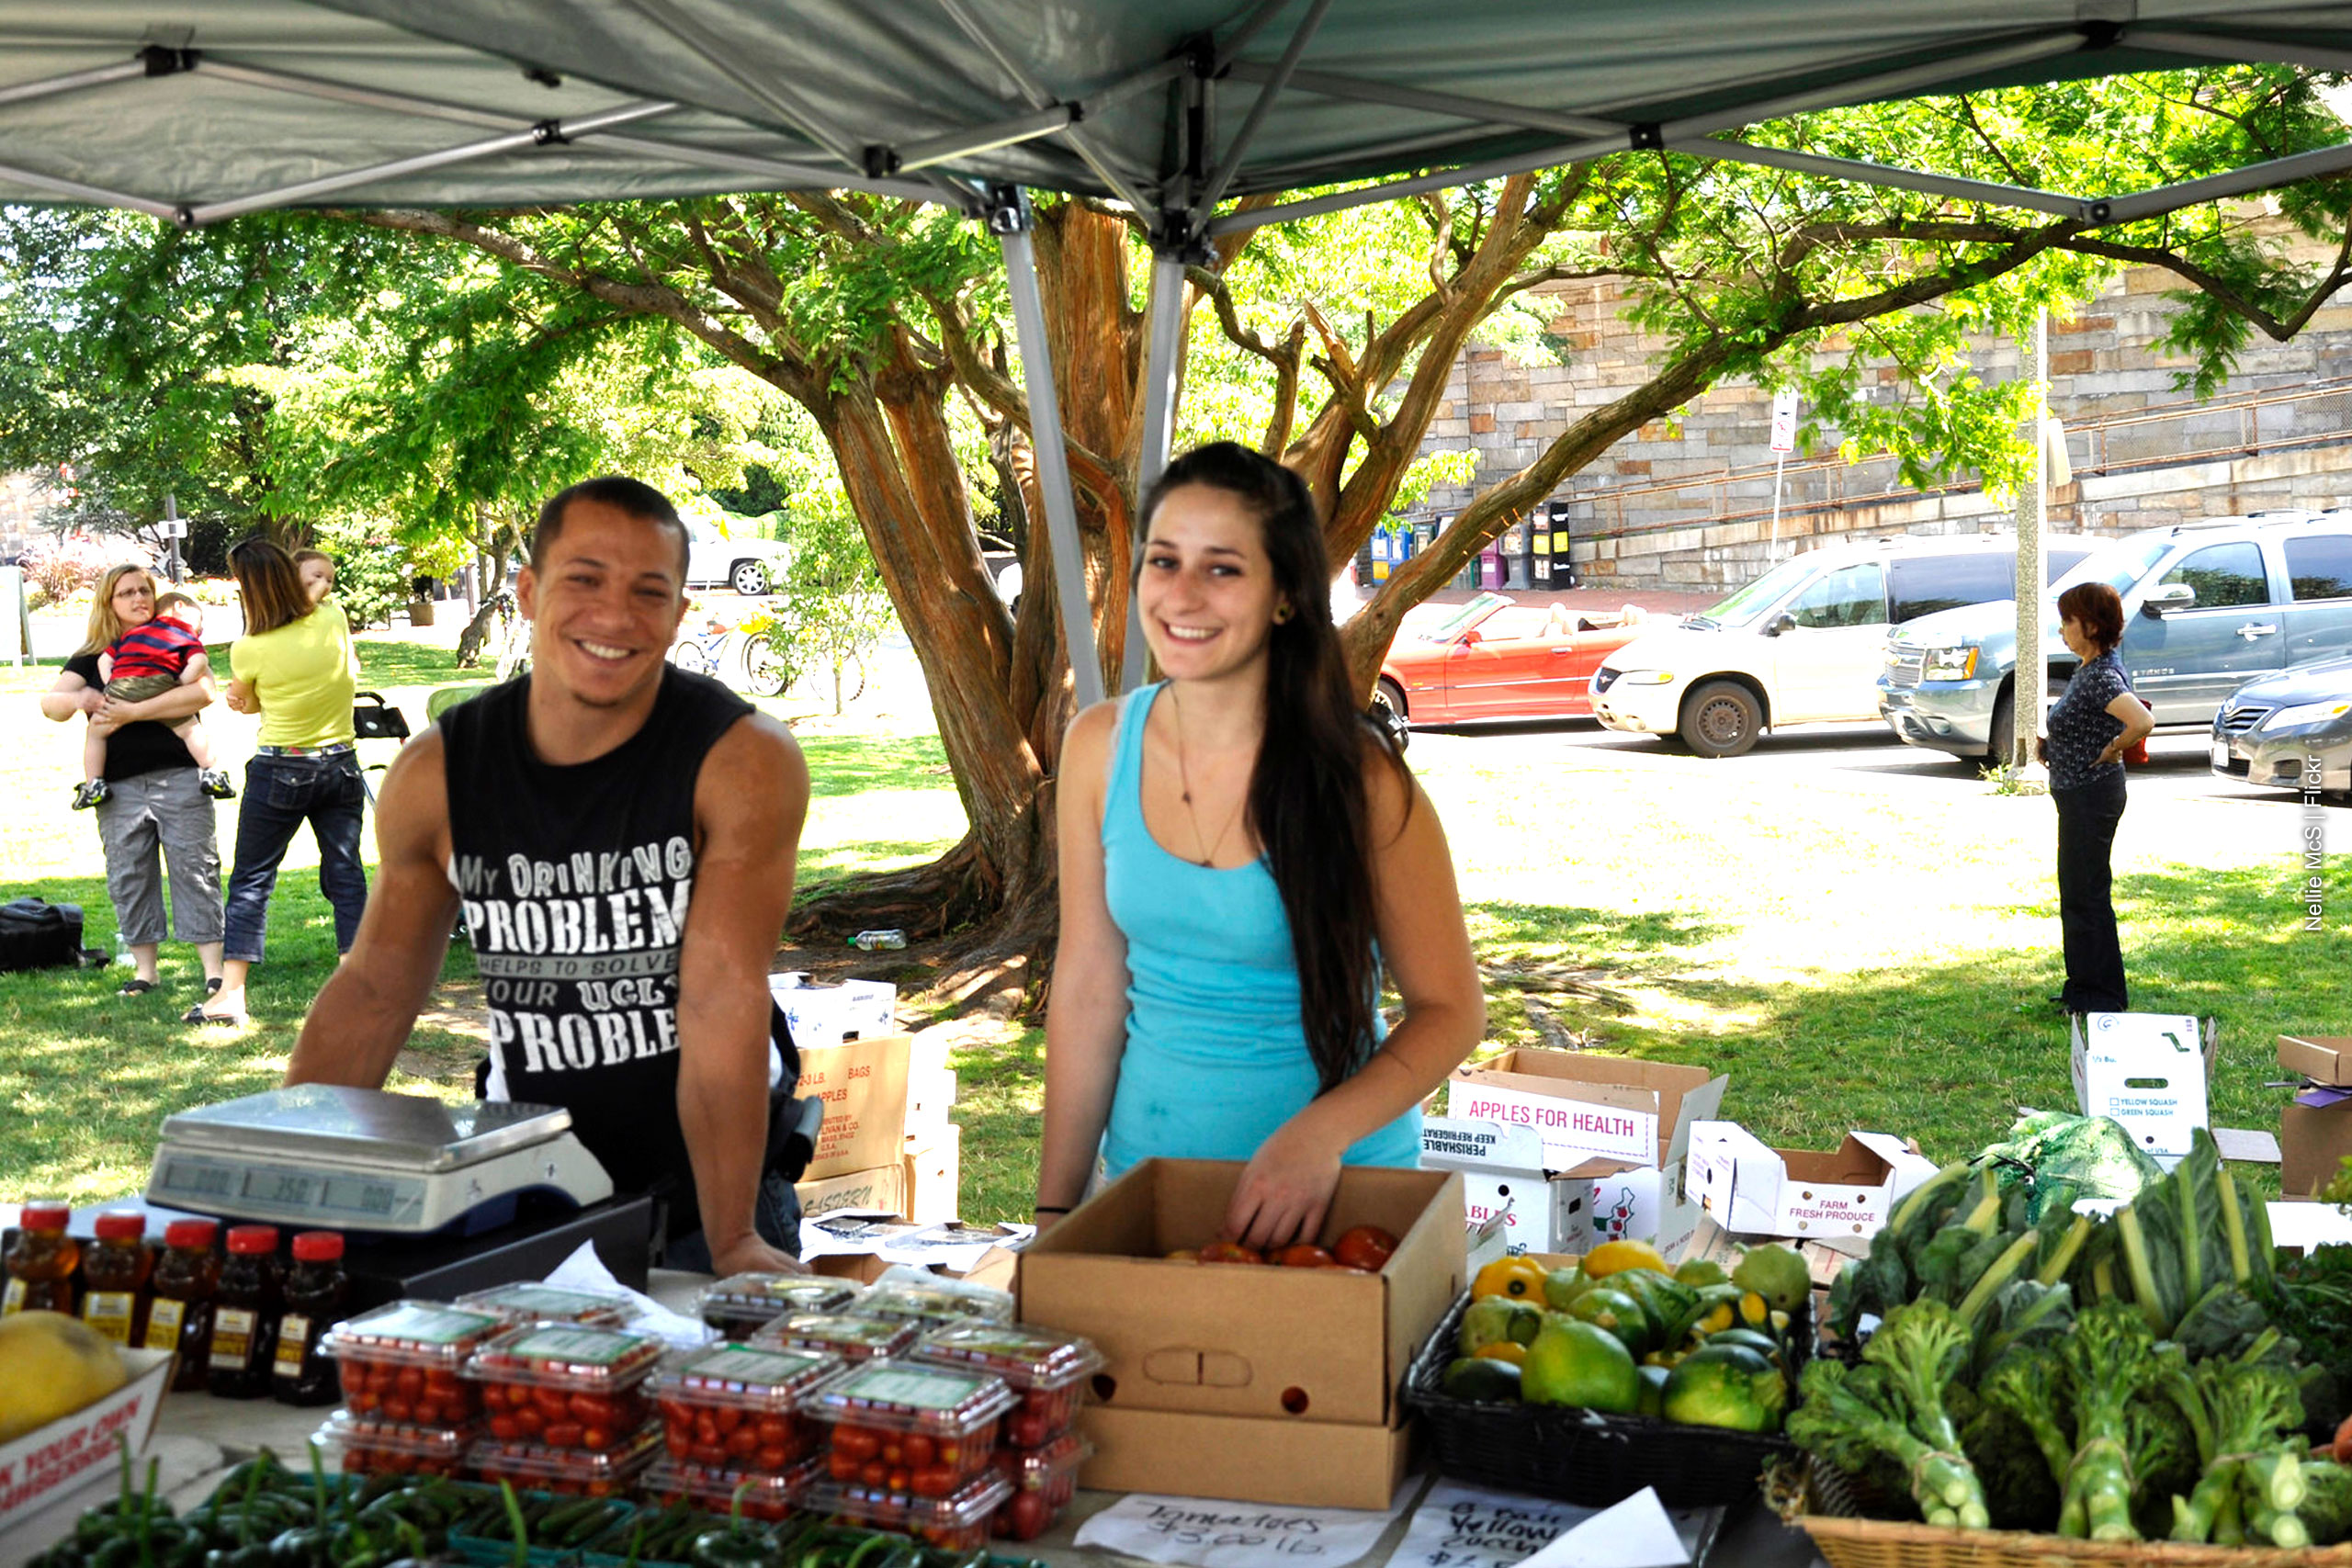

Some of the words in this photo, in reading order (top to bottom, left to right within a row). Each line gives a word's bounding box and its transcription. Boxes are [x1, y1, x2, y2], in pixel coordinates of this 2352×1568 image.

[480, 957, 542, 975] HELPS
[554, 961, 578, 975] TO
[591, 953, 677, 975] SOLVE
[847, 1066, 871, 1079] BAGS
[1469, 1100, 1531, 1124] APPLES
[1536, 1108, 1567, 1128] FOR
[1573, 1113, 1634, 1137] HEALTH
[1423, 1139, 1487, 1156] PERISHABLE
[1474, 1134, 1497, 1145] KEEP
[1819, 1200, 1849, 1211] FARM
[1790, 1209, 1824, 1220] FRESH
[1825, 1210, 1875, 1223] PRODUCE
[1137, 1501, 1322, 1534] Tomatoes
[1450, 1516, 1560, 1540] Yellow
